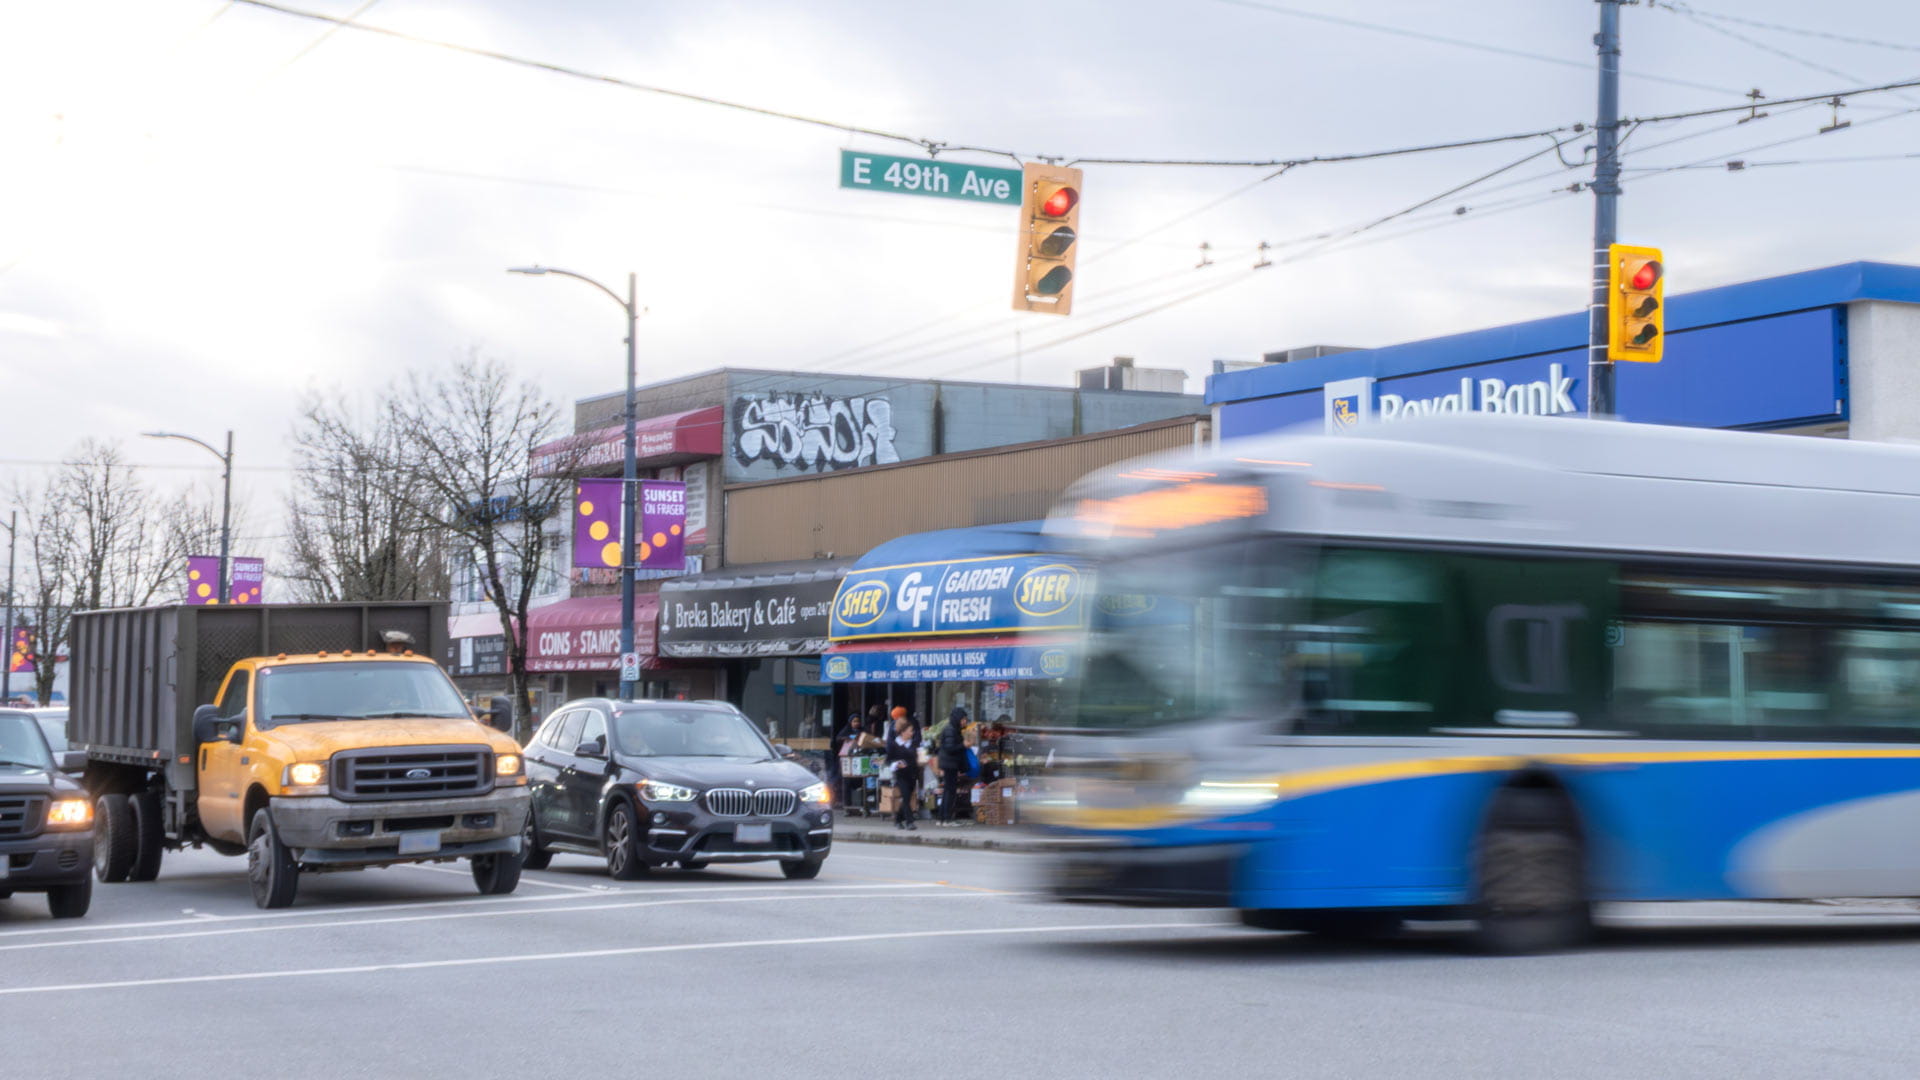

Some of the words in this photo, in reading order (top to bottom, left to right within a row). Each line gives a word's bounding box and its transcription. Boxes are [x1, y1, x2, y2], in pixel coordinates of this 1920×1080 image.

[853, 157, 872, 185] E
[884, 161, 949, 193] 49th
[960, 170, 1011, 200] Ave
[1480, 363, 1577, 416] Bank
[644, 488, 685, 502] SUNSET
[644, 503, 656, 515] ON
[657, 503, 685, 516] FRASER
[945, 566, 1015, 594] GARDEN
[1020, 574, 1069, 605] SHER
[675, 602, 708, 629] Breka
[710, 600, 752, 633] Bakery
[753, 600, 764, 626] &
[767, 597, 796, 626] Café
[800, 606, 817, 622] open
[842, 588, 884, 618] SHER
[896, 572, 933, 628] GF
[941, 597, 992, 623] FRESH
[540, 632, 571, 656] COINS
[580, 629, 622, 654] STAMPS
